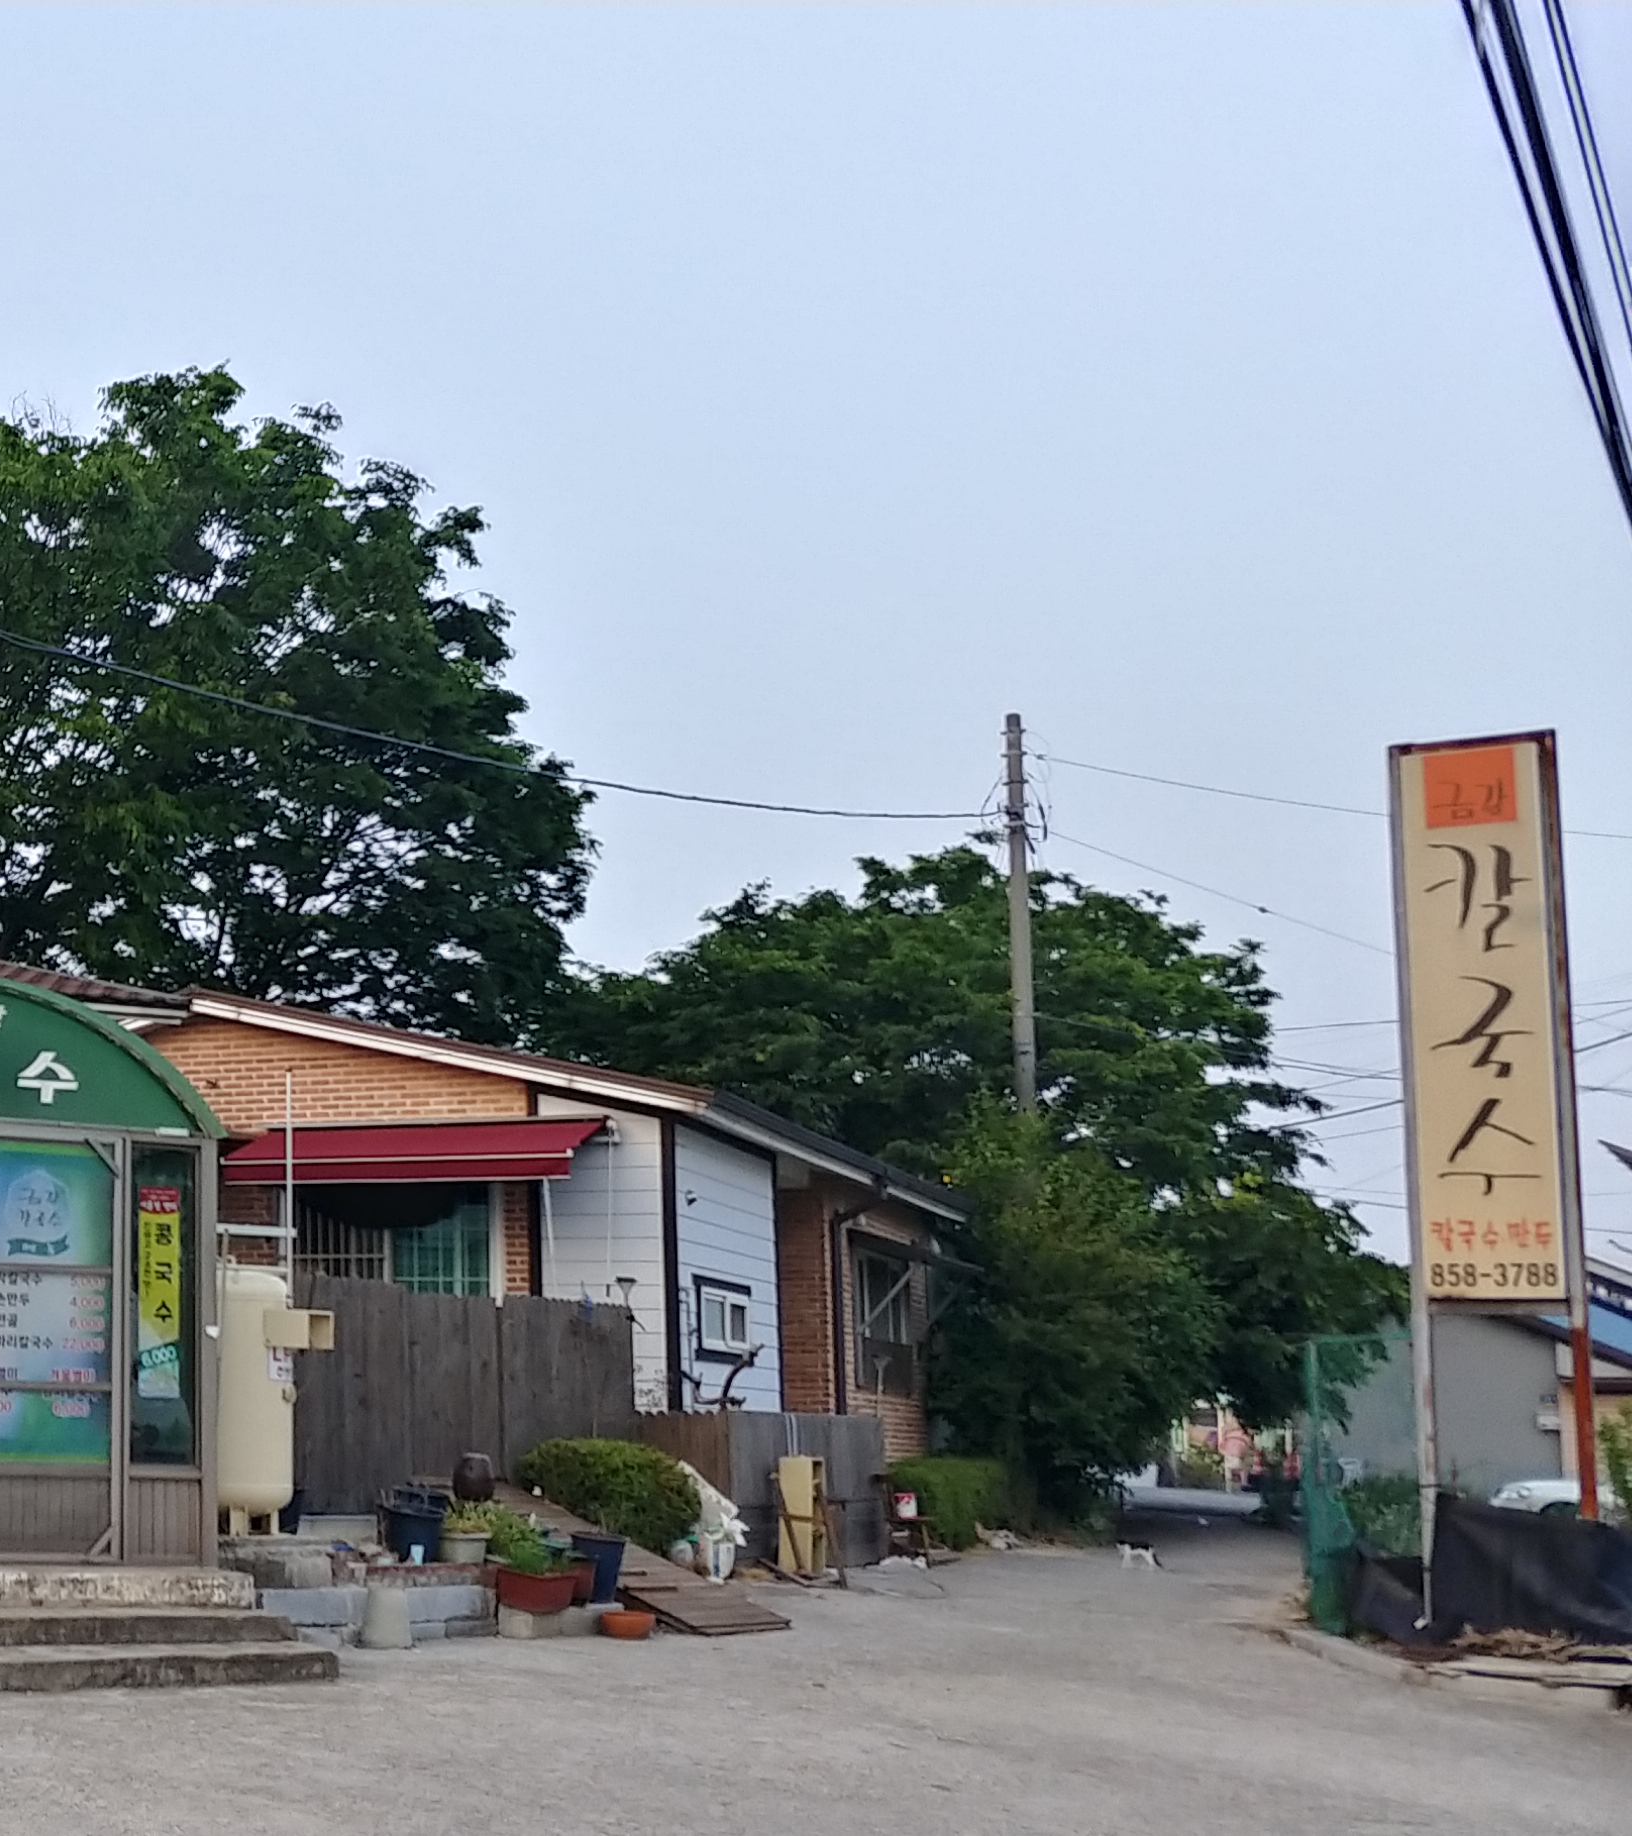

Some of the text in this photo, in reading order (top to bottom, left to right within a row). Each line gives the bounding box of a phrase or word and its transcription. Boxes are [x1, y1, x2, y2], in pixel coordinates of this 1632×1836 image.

[1433, 778, 1509, 820] 금강
[1423, 843, 1542, 1196] 칼국수
[1430, 1262, 1558, 1287] 858-3788
